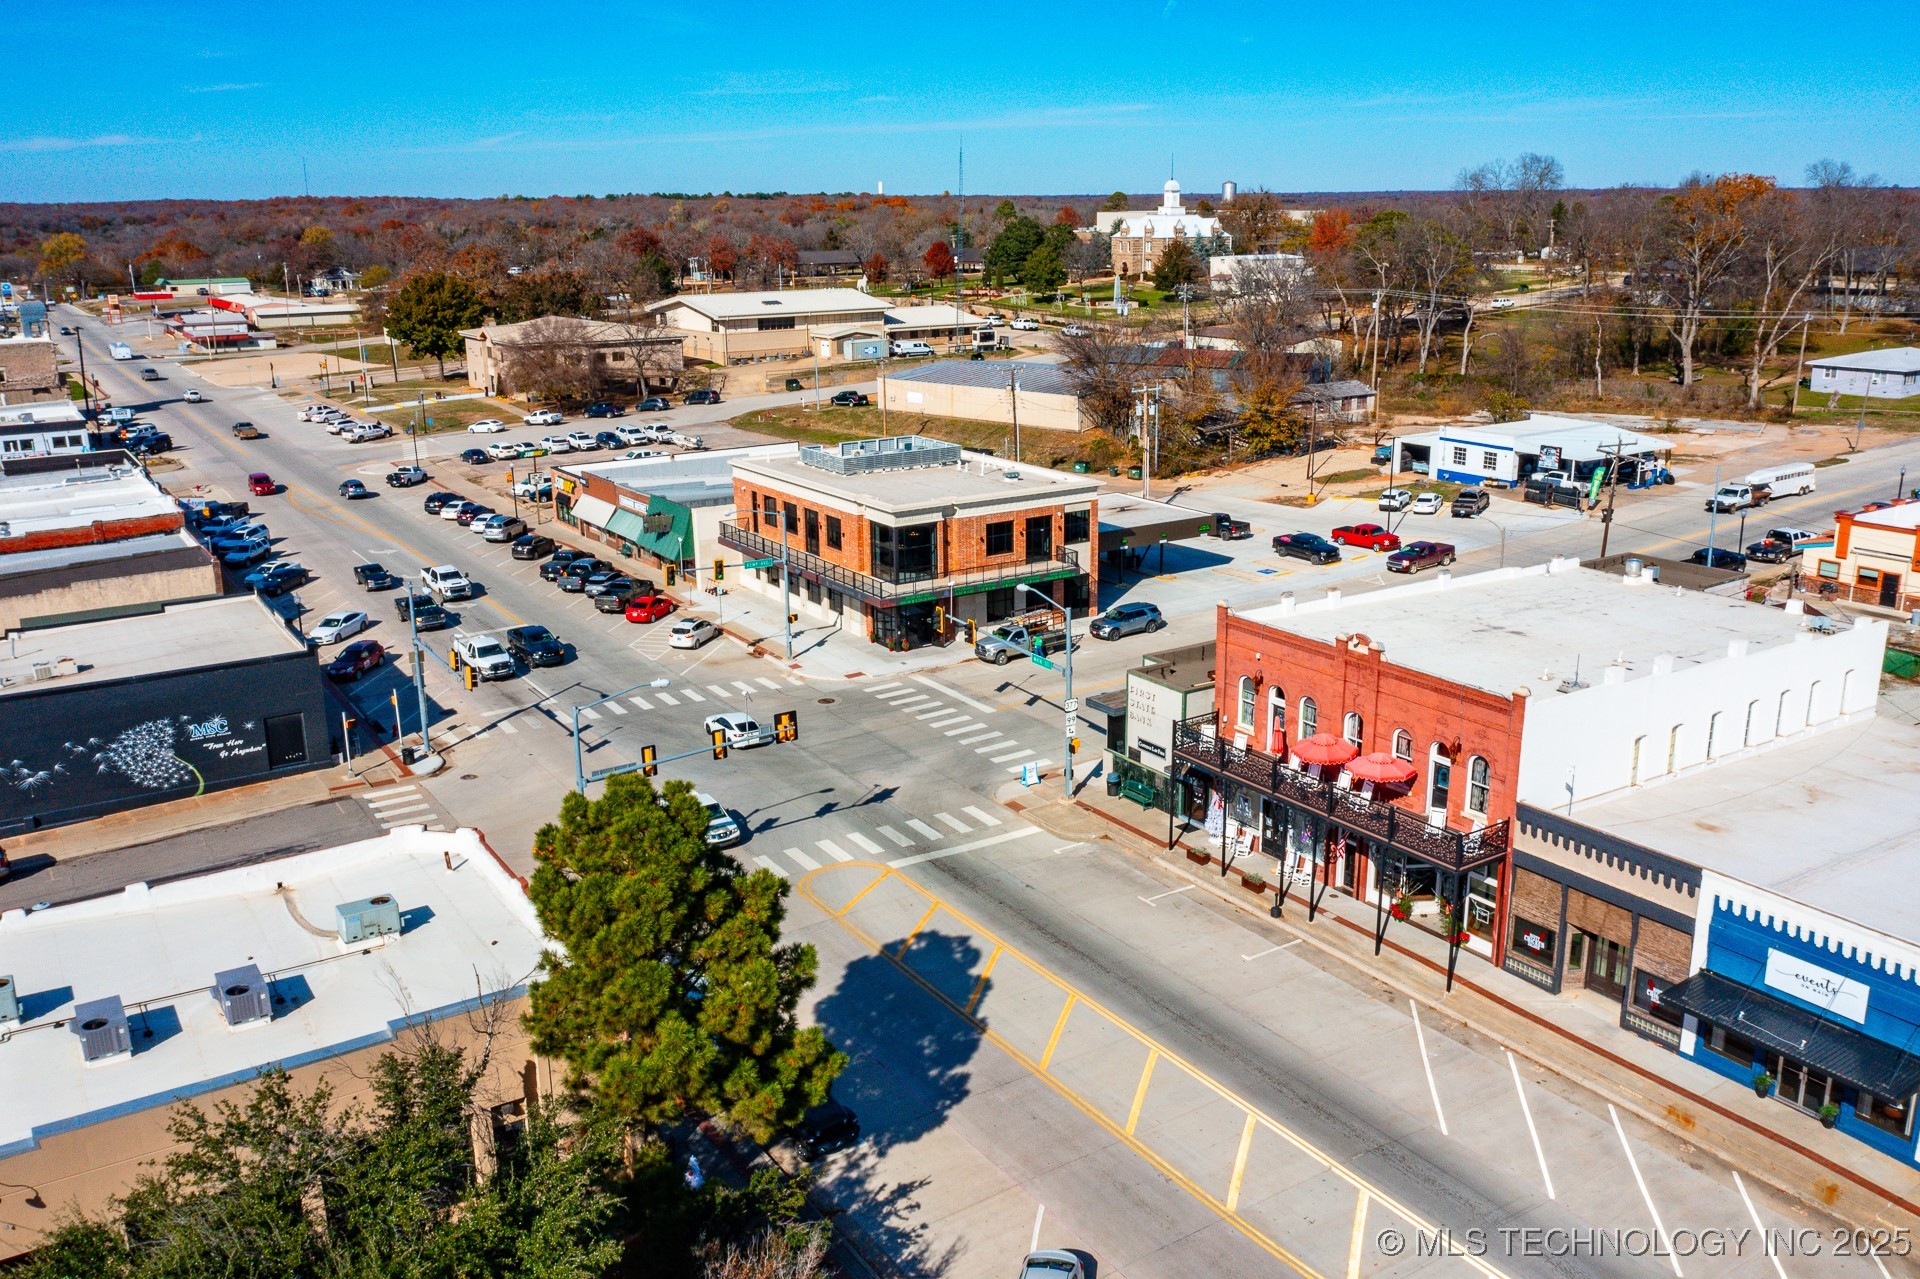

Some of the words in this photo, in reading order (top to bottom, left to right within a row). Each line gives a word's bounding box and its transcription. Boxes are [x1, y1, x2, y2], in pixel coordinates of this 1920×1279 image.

[1130, 686, 1156, 701] FIRST
[1065, 701, 1078, 710] 377
[1130, 699, 1156, 715] STATE
[1067, 716, 1076, 724] 99
[1129, 711, 1152, 726] BANK
[191, 719, 228, 738] MSC
[226, 739, 244, 747] Here
[219, 750, 228, 759] Go
